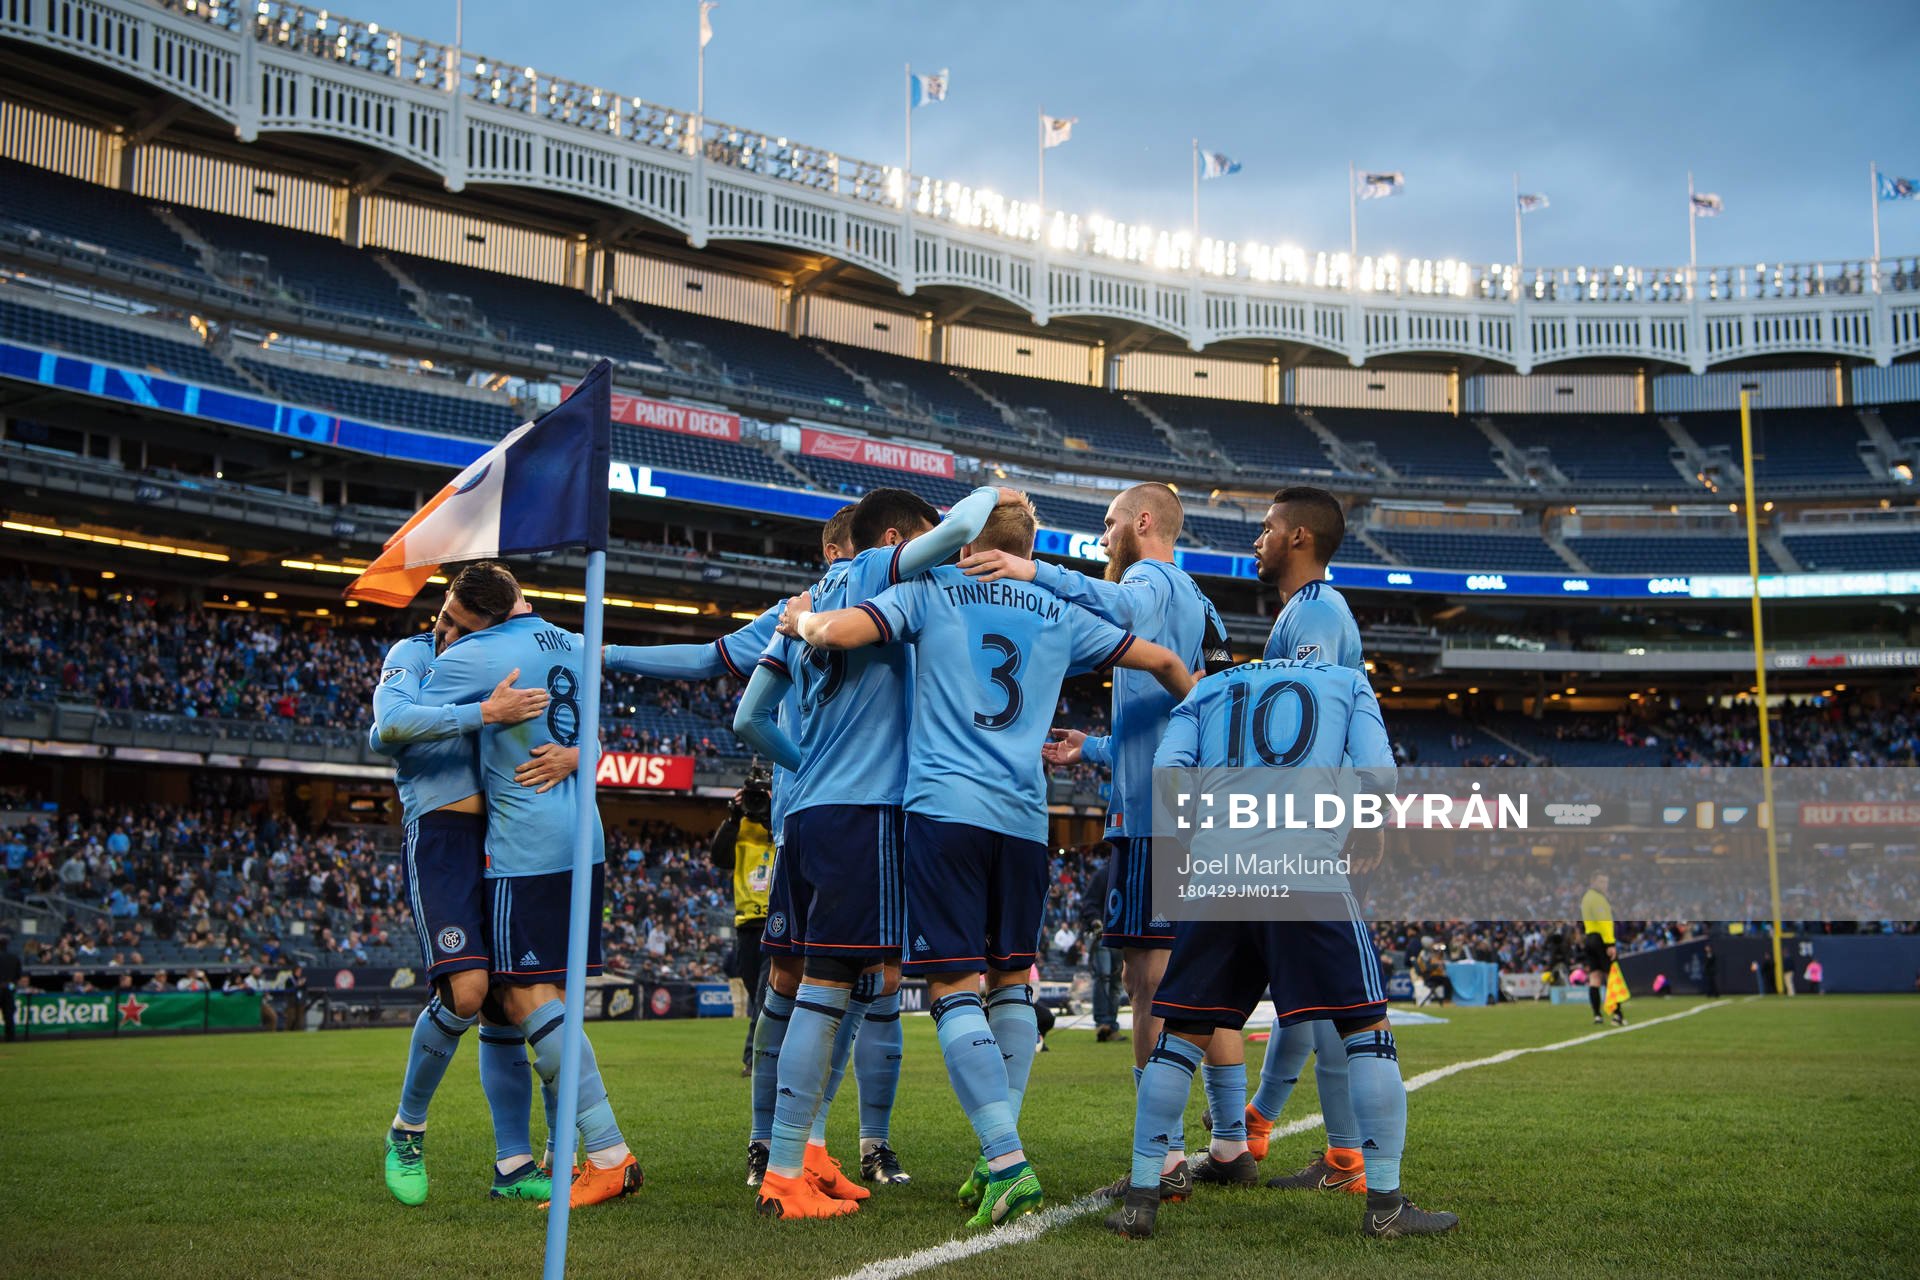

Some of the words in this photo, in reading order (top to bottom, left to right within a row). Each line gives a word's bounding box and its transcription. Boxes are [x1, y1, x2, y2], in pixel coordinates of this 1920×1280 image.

[635, 401, 687, 430] PARTY
[688, 412, 732, 437] DECK
[864, 442, 908, 468] PARTY
[910, 450, 947, 475] DECK
[608, 462, 667, 498] AL
[1466, 574, 1508, 591] GOAL
[1647, 577, 1690, 594] GOAL
[943, 582, 1061, 623] TINNERHOLM
[533, 630, 572, 652] RING
[1223, 659, 1334, 678] MORALEZ
[1807, 653, 1847, 668] Audi
[973, 633, 1024, 732] 3
[546, 664, 581, 748] 8
[1227, 679, 1319, 773] 10
[597, 754, 666, 786] AVIS
[1803, 804, 1920, 825] RUTGERS
[13, 999, 109, 1025] ineken
[700, 991, 733, 1006] GEIC
